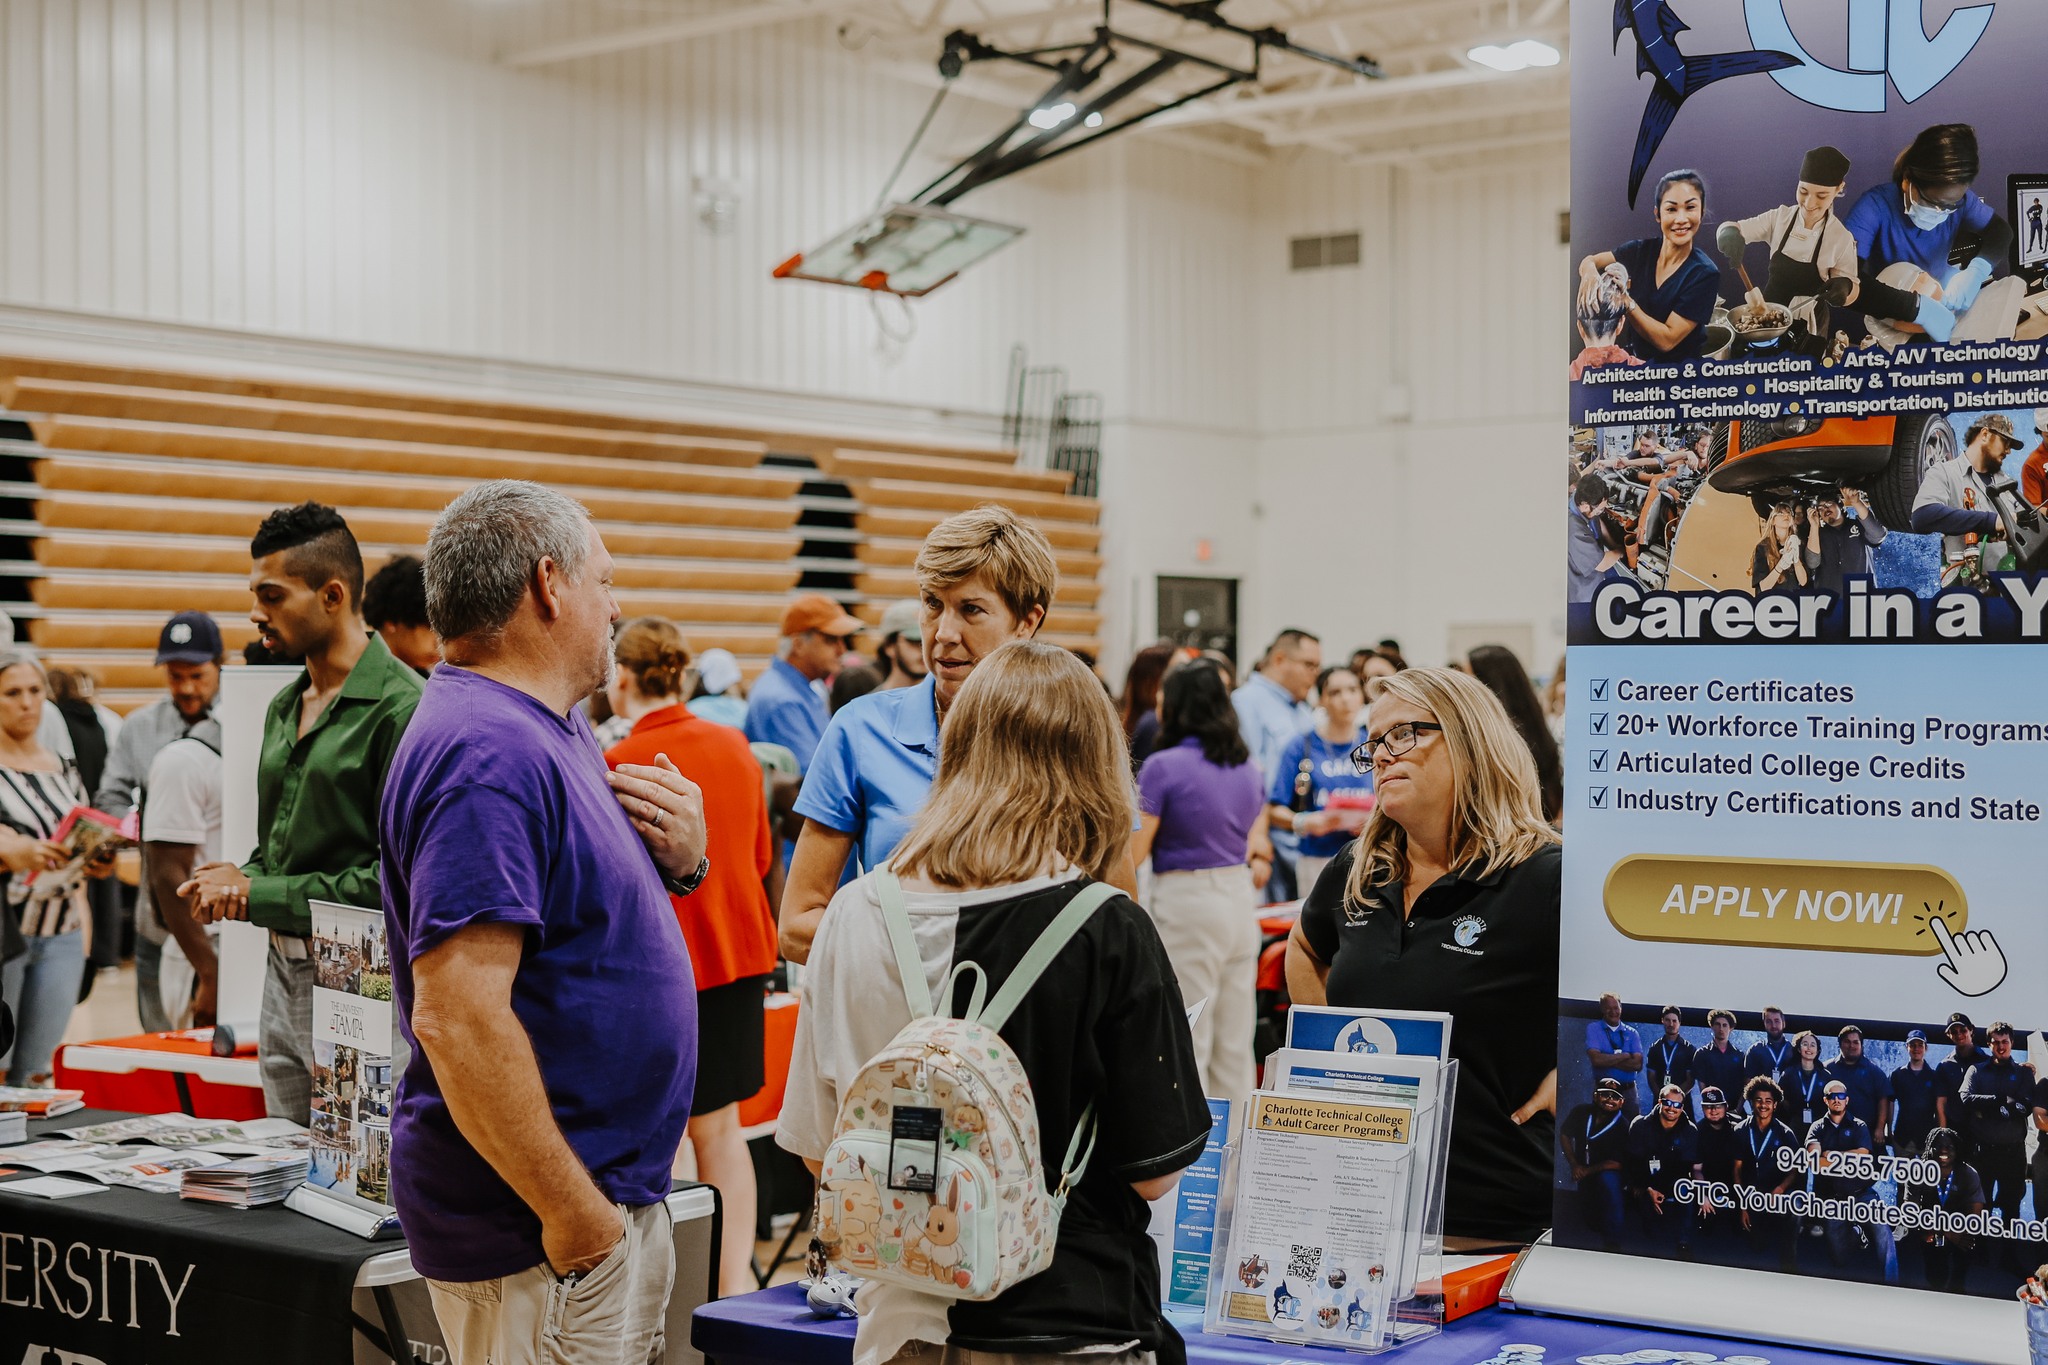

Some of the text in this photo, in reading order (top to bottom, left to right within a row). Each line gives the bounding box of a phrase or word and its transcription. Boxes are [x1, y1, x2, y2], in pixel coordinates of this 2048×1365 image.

[1583, 342, 2040, 385] Architecture & Construction Arts, A/V Technology
[1613, 369, 2048, 403] Health Science Hospitality & Tourism Human
[1585, 406, 1675, 424] Information
[1680, 401, 1781, 419] Technology
[1805, 395, 1948, 412] Transportation,
[1596, 582, 1832, 639] Career
[1850, 579, 1914, 638] in
[1935, 593, 1982, 638] a
[1617, 680, 1854, 702] Career Certificates
[1617, 714, 1658, 735] 20+
[1667, 714, 1798, 737] Workforce
[1807, 716, 1914, 745] Training
[1616, 751, 1965, 782] Articulated College Credits
[1617, 788, 2040, 821] Industry Certifications and State
[1660, 884, 1903, 925] APPLY NOW!
[334, 1013, 364, 1040] TAMPA
[1265, 1104, 1403, 1126] Charlotte Technical College
[1275, 1117, 1391, 1137] Adult Career Programs
[1776, 1146, 1940, 1186] 941.255.7500
